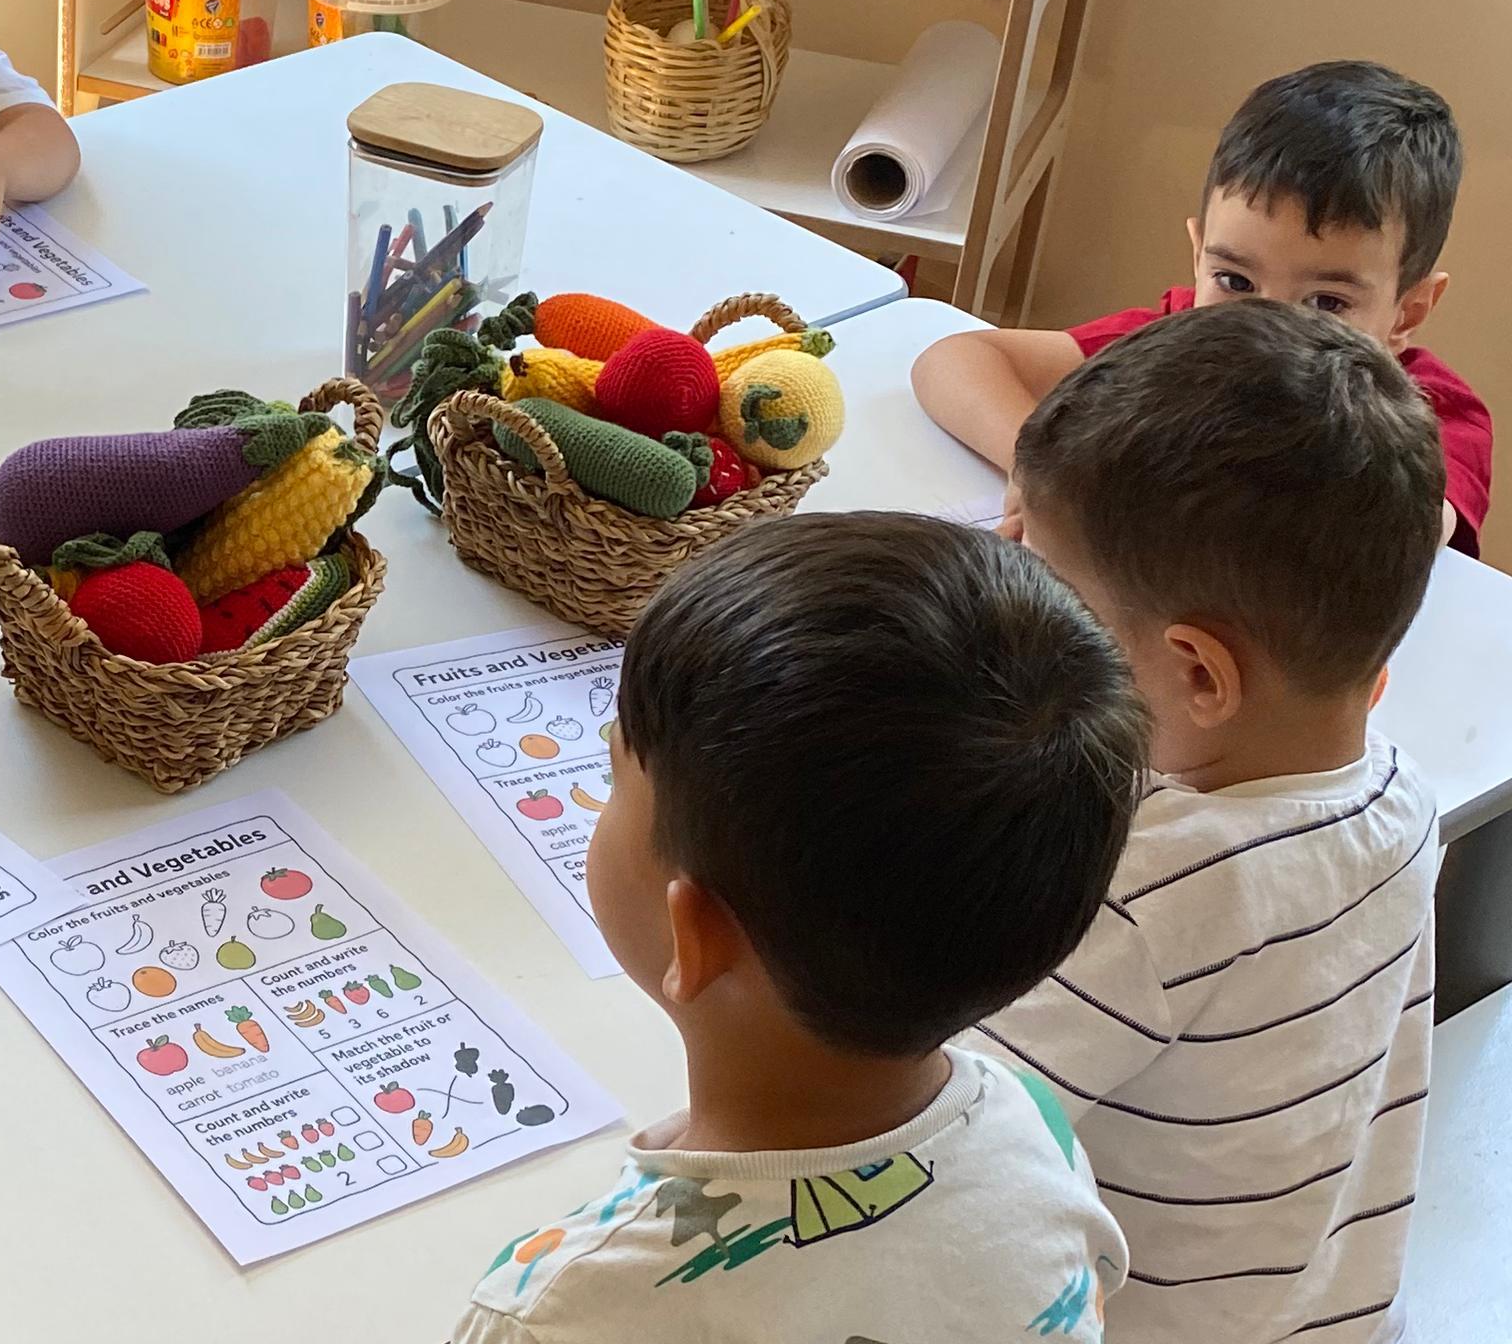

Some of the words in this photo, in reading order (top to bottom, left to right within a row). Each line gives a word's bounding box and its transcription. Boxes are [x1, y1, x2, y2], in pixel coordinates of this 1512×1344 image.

[11, 226, 40, 242] and
[32, 241, 94, 287] Vegetables
[413, 664, 483, 687] Fruits
[486, 655, 529, 674] and
[528, 637, 626, 664] Vegetab
[427, 691, 461, 706] Color
[464, 687, 486, 700] the
[487, 680, 523, 695] fruits
[524, 675, 549, 688] and
[550, 661, 621, 683] vegetables
[493, 775, 533, 789] Trace
[533, 770, 557, 782] the
[558, 760, 604, 776] names
[540, 823, 579, 838] apple
[86, 870, 133, 895] and
[131, 828, 267, 879] Vegetables
[27, 922, 64, 942] Color
[65, 918, 90, 929] the
[90, 904, 129, 921] fruits
[130, 892, 157, 909] and
[156, 869, 231, 898] vegetables
[260, 964, 304, 987] Count
[305, 954, 333, 972] and
[330, 943, 369, 962] write
[270, 981, 296, 998] the
[298, 962, 357, 986] numbers
[109, 1020, 152, 1039] Trace
[151, 1007, 178, 1025] the
[177, 993, 225, 1016] names
[318, 1028, 332, 1040] 5
[347, 1017, 362, 1030] 3
[376, 1007, 390, 1019] 6
[413, 994, 428, 1006] 2
[330, 1039, 377, 1062] Match
[377, 1032, 404, 1048] the
[401, 1019, 436, 1038] fruit
[436, 1012, 453, 1024] or
[165, 1075, 206, 1097] apple
[211, 1054, 268, 1078] banana
[343, 1042, 415, 1074] vegetable
[413, 1036, 432, 1050] to
[353, 1072, 377, 1087] its
[375, 1051, 432, 1079] shadow
[177, 1088, 223, 1113] carrot
[226, 1069, 280, 1094] tomato
[194, 1113, 244, 1135] Count
[242, 1100, 272, 1118] and
[271, 1087, 311, 1107] write
[205, 1130, 233, 1147] the
[233, 1108, 298, 1136] numbers
[336, 1170, 357, 1186] 2
